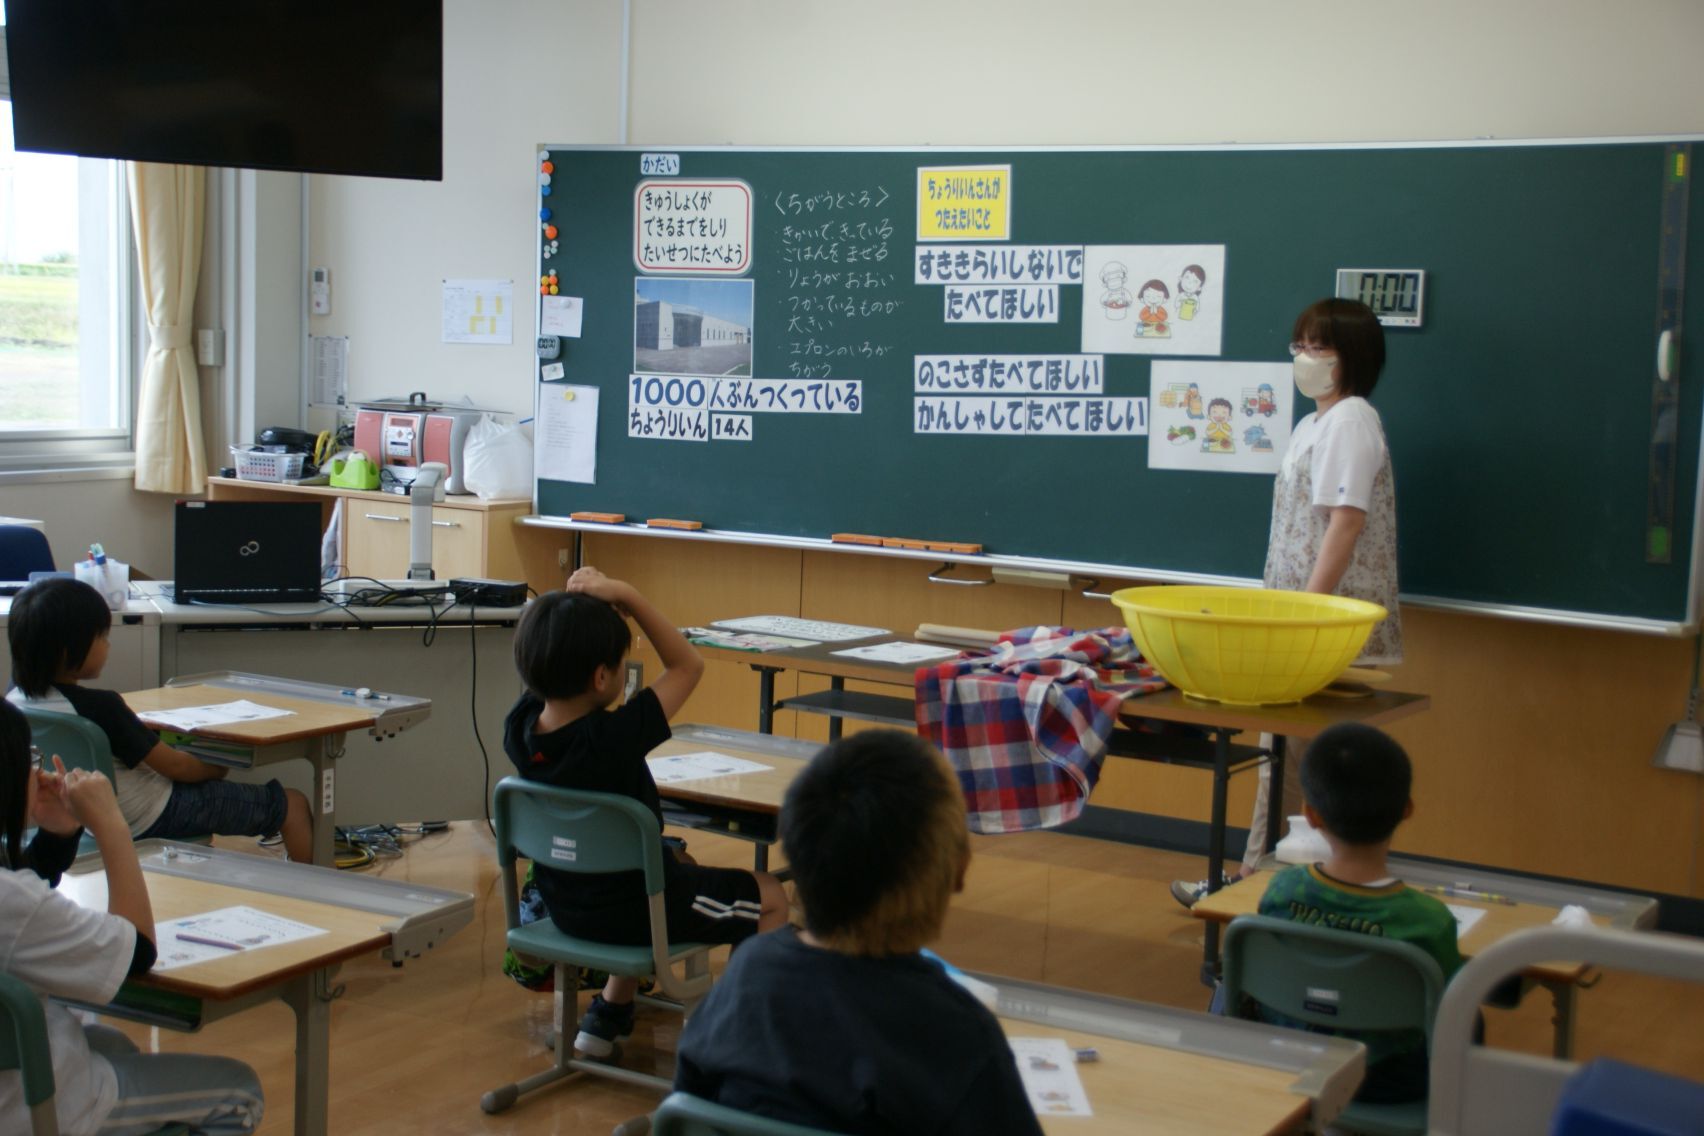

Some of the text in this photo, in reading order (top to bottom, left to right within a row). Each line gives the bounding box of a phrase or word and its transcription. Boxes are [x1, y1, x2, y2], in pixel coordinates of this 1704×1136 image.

[642, 156, 677, 173] かだい
[928, 176, 1000, 200] ちょうりいんさんが
[644, 190, 712, 211] きゅうしょくが
[643, 216, 727, 238] できるまでをしり
[935, 207, 991, 230] つたえたいこと
[643, 243, 743, 265] たいせつにたべよう
[919, 249, 1082, 281] すききらいしないで
[946, 288, 1054, 320] たべてほしい
[788, 361, 832, 378] ちがう
[918, 358, 1099, 391] のこさずたべてほしい
[631, 408, 750, 439] ちょうりいん 14人
[918, 400, 1145, 432] かんしゃしてたべてほしい
